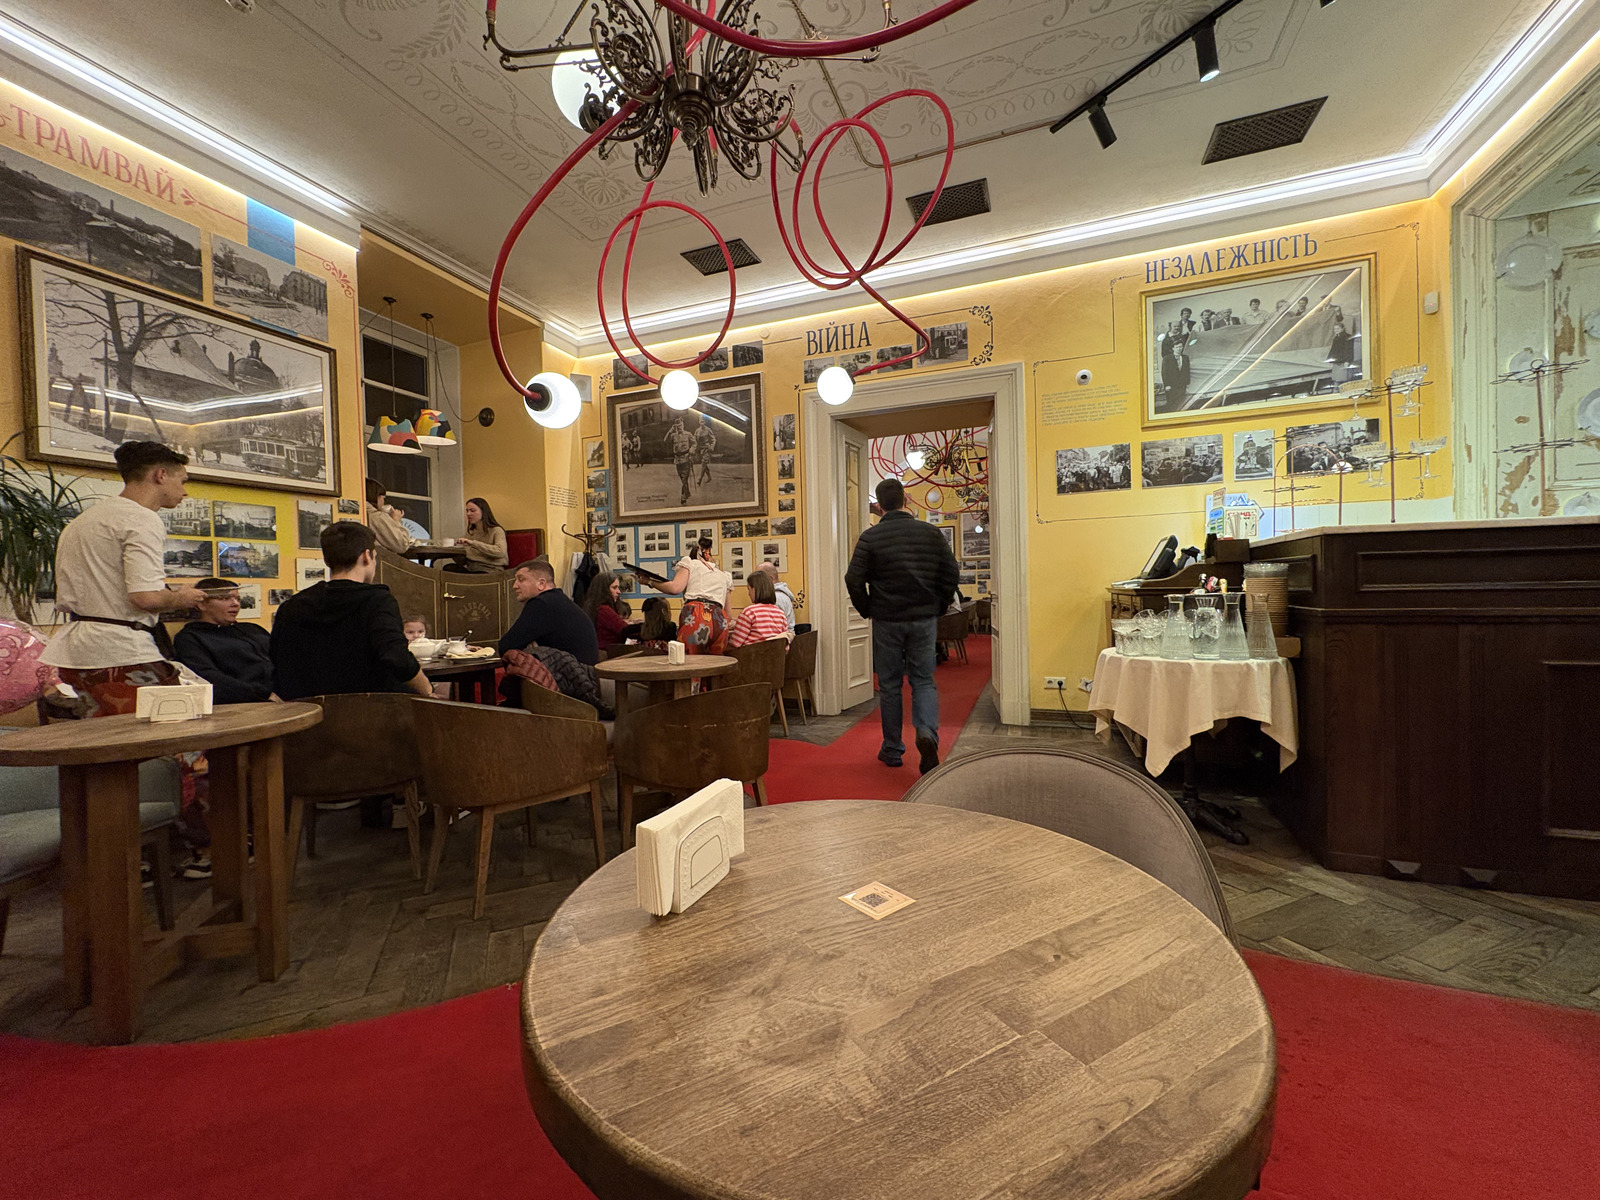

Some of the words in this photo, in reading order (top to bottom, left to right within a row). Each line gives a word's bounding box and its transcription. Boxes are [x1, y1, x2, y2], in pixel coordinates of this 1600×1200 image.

[10, 104, 177, 205] ТРАМВАЙ
[1145, 233, 1318, 284] НЕЗАЛЕЖНІСТЬ
[806, 321, 872, 356] ВІЙНА
